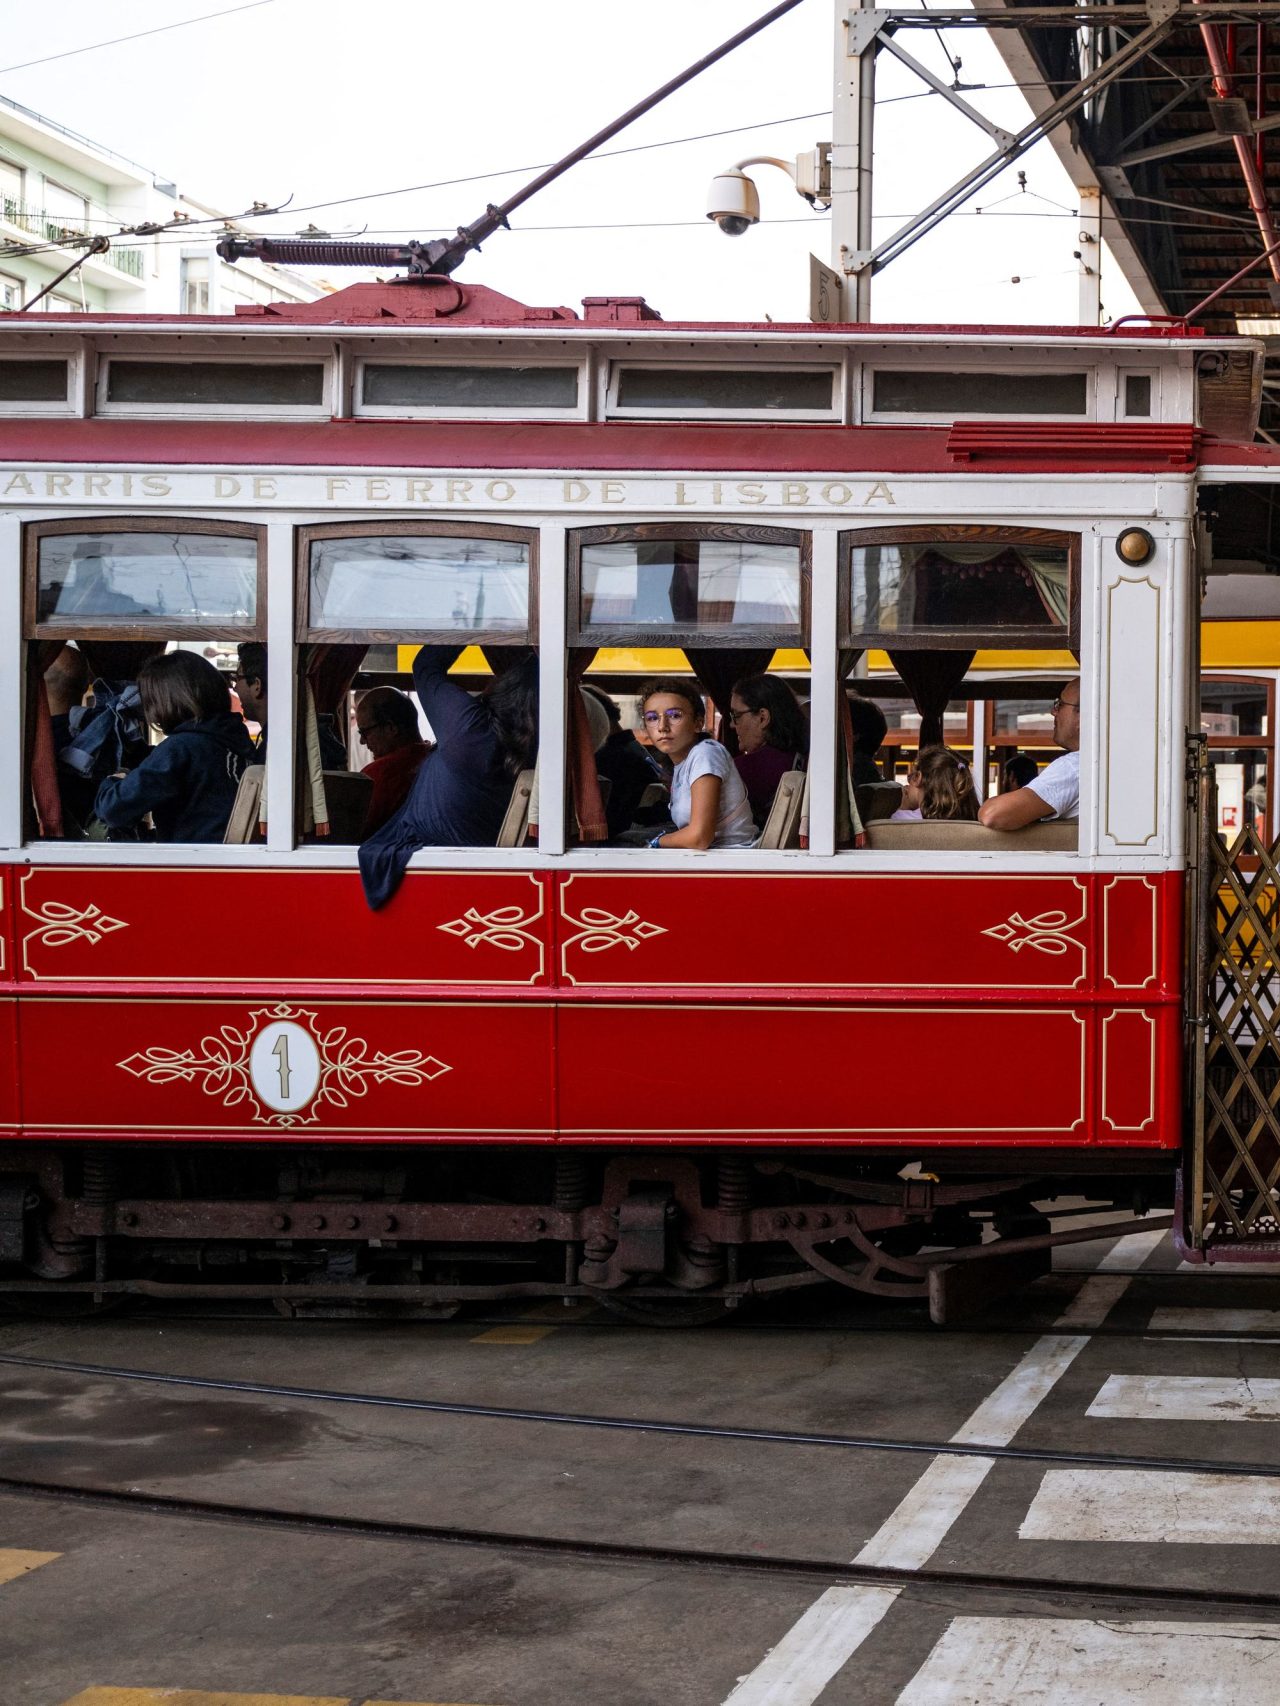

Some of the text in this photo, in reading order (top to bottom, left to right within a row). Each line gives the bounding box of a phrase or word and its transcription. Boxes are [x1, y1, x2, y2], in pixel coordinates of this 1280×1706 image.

[2, 472, 897, 506] ARRIS DE FERRO DE LISBOA
[271, 1034, 293, 1099] 1
